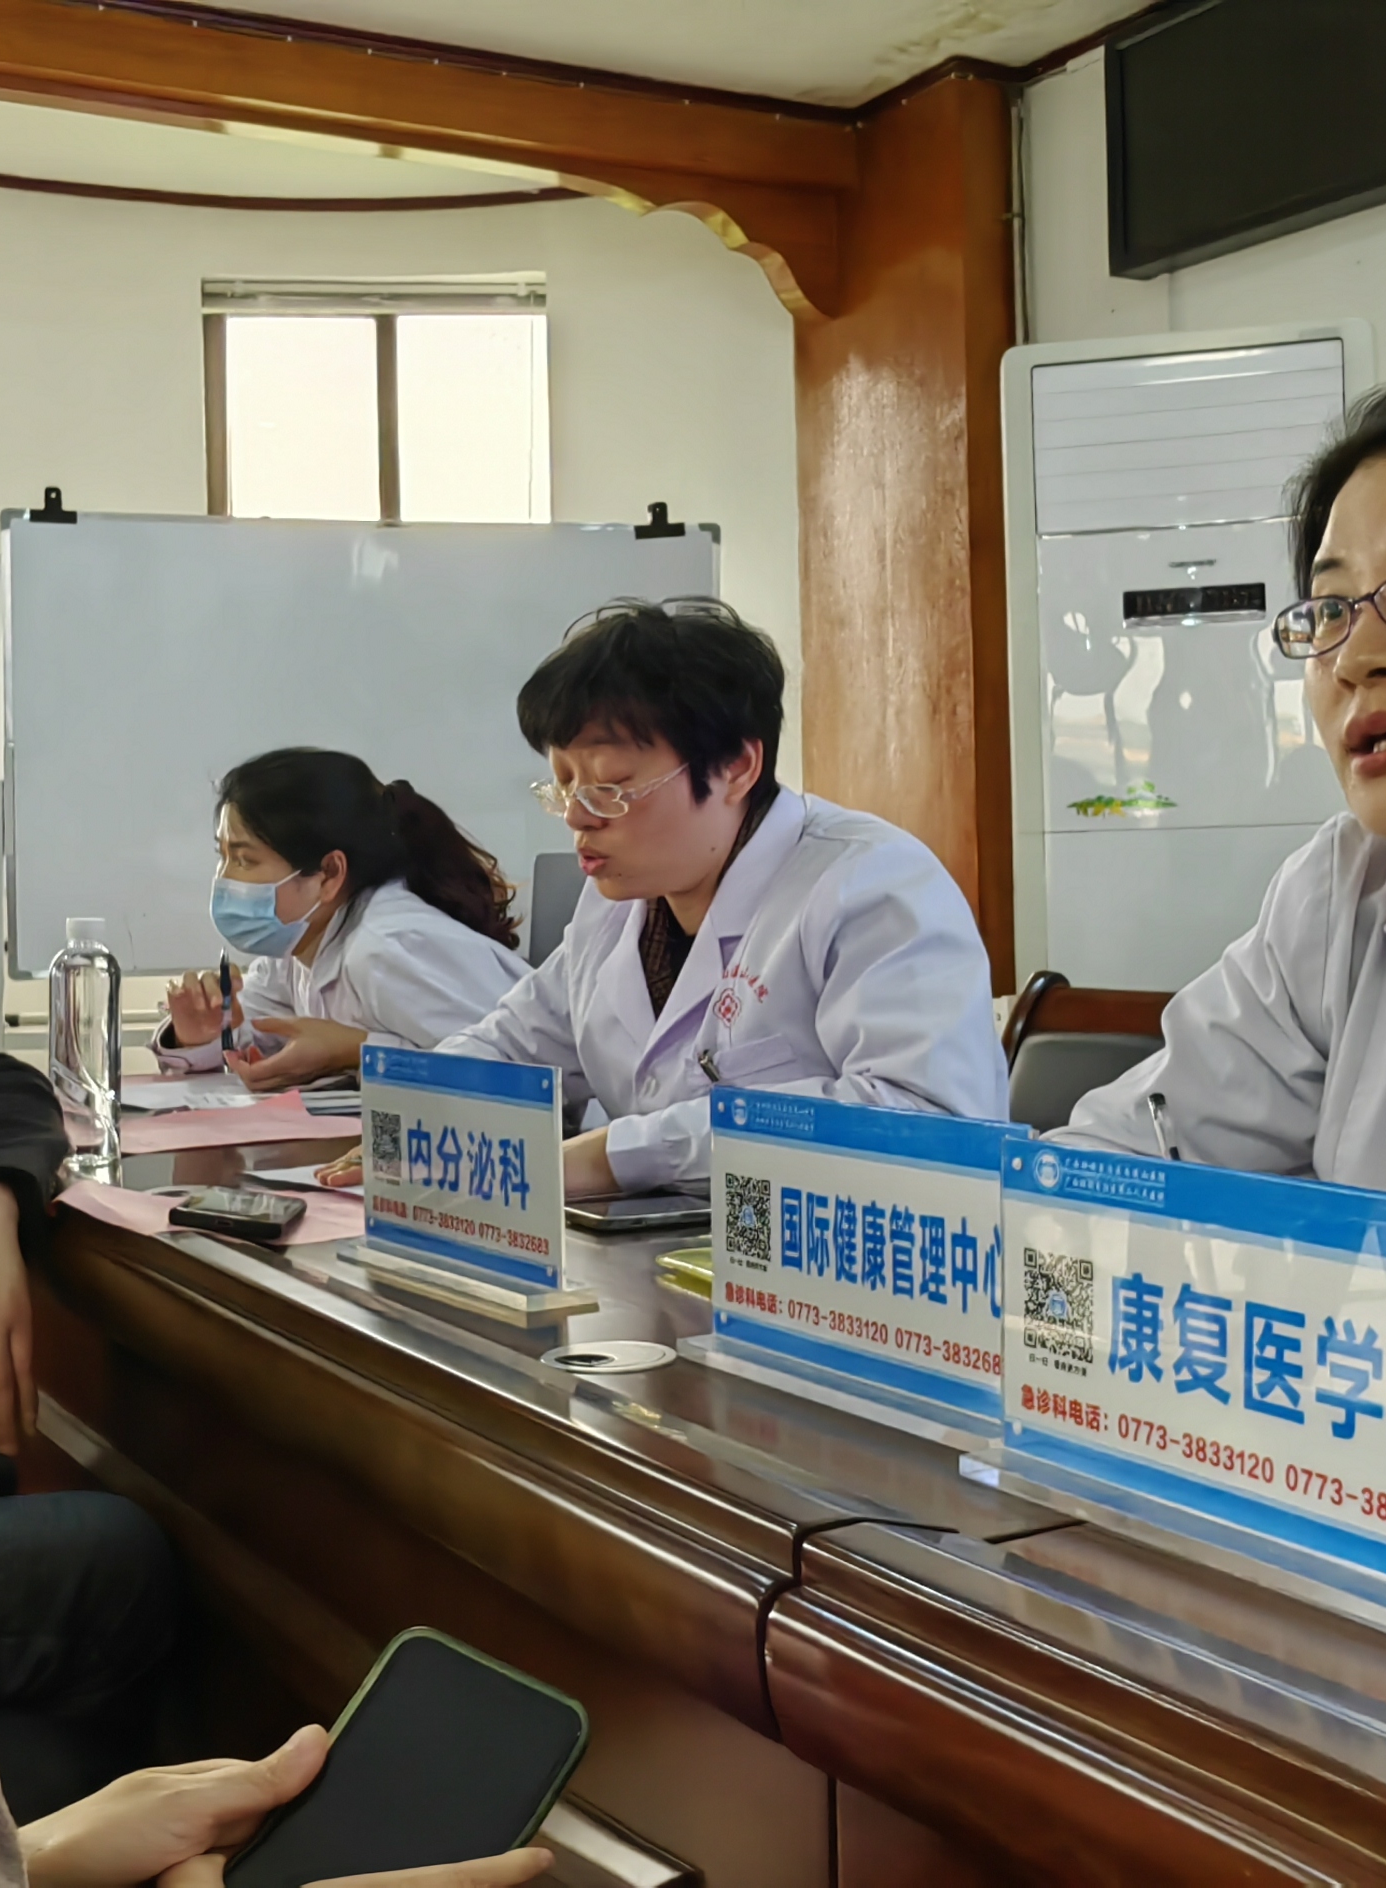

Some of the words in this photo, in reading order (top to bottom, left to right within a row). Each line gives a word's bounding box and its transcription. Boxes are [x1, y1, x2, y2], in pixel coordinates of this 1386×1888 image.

[406, 1118, 530, 1209] 内分泌科
[780, 1186, 1002, 1319] 国际健康管理中心
[787, 1299, 889, 1345] 0773-3833120
[1117, 1413, 1275, 1485] 0773-3833120
